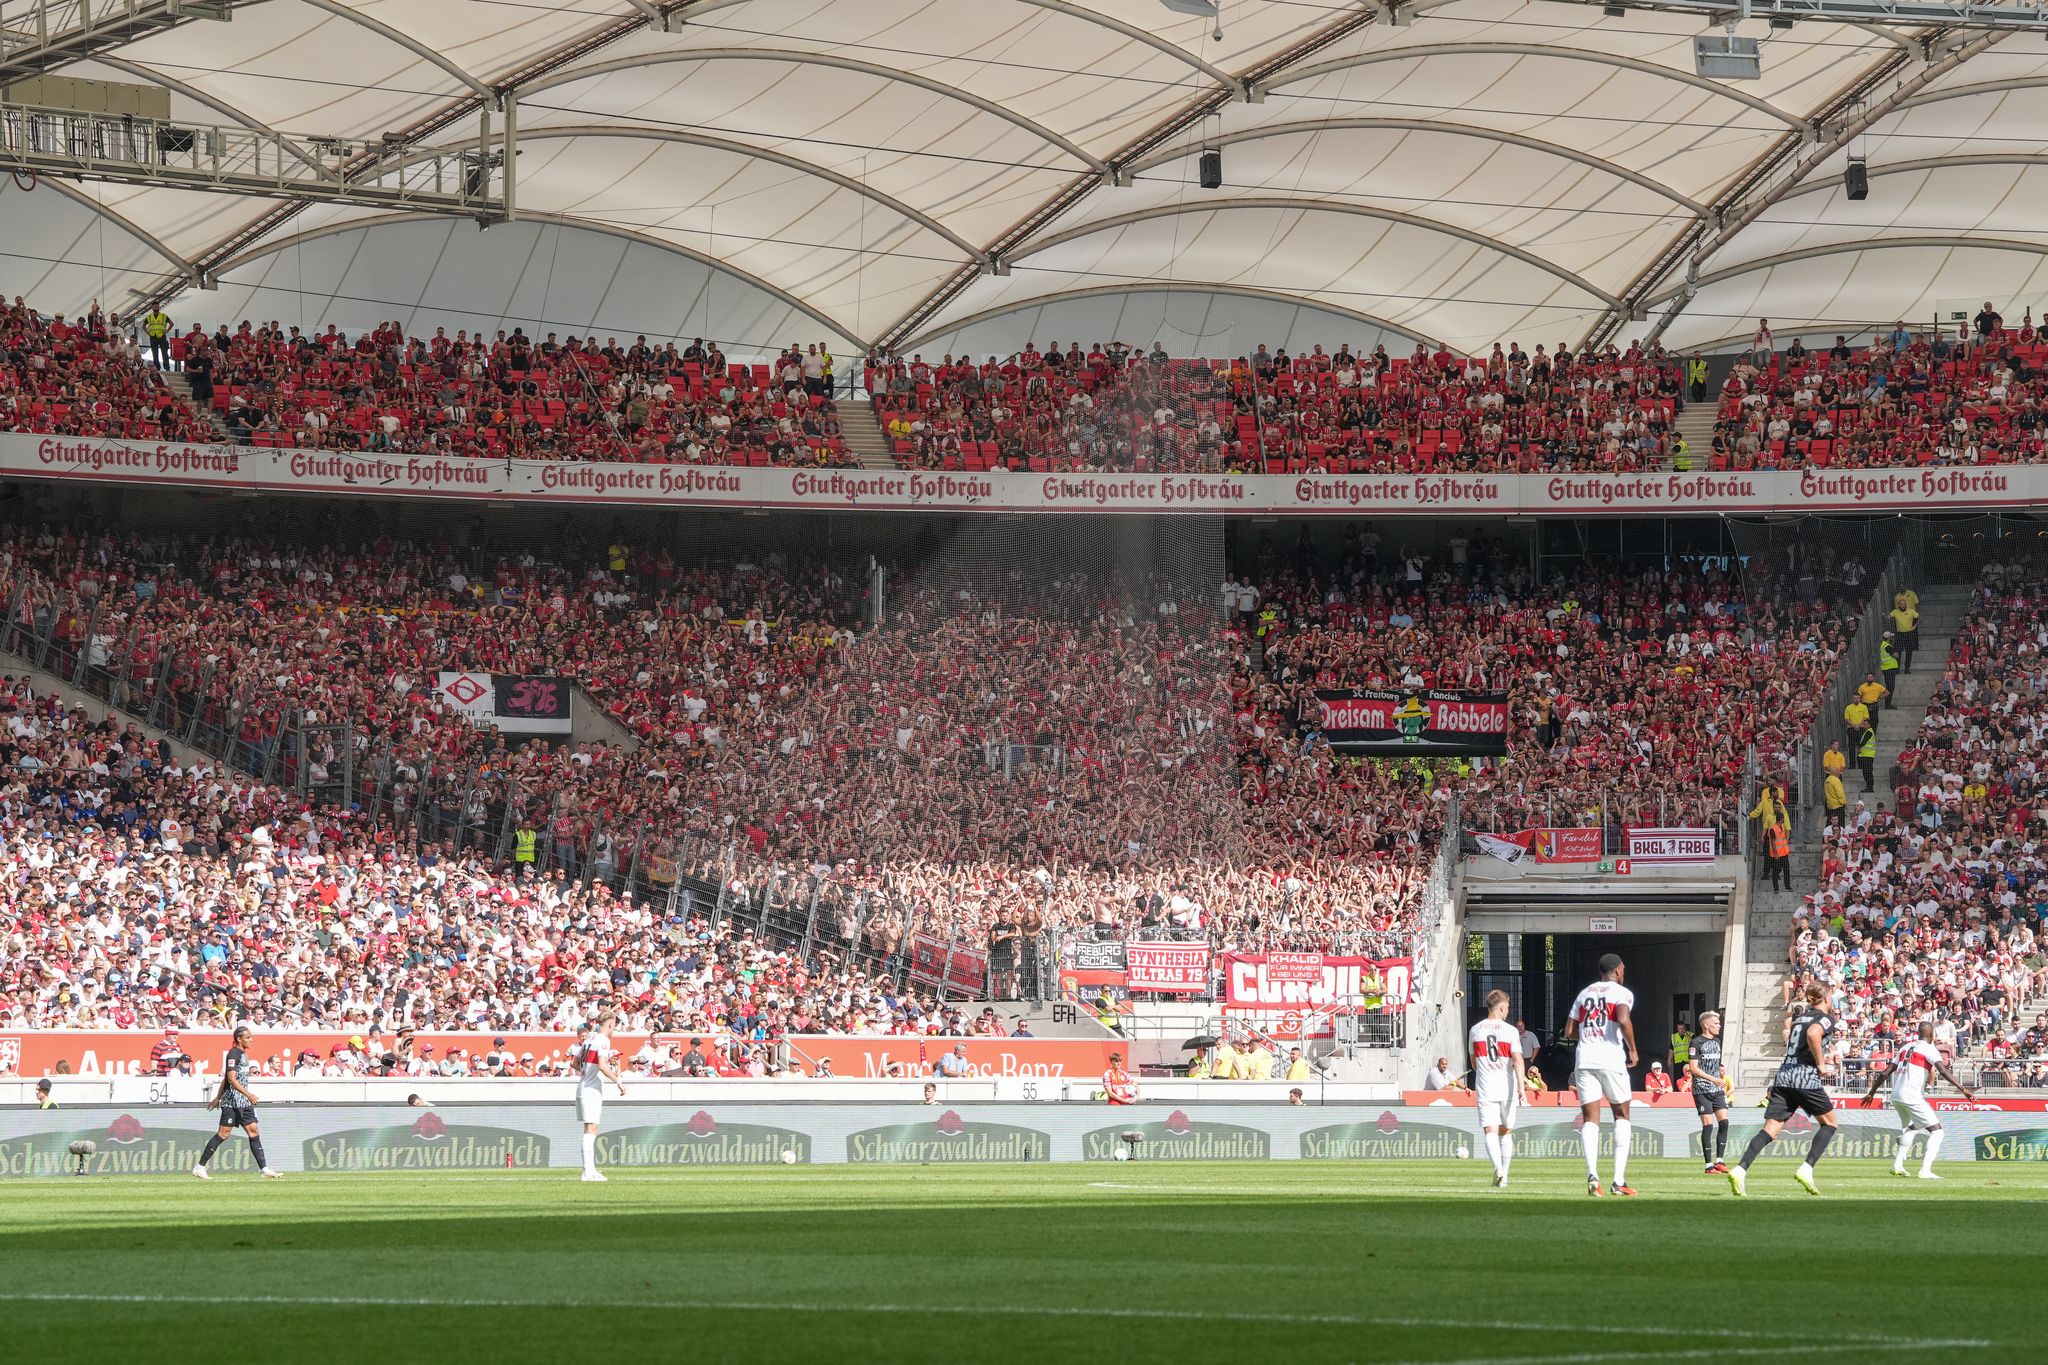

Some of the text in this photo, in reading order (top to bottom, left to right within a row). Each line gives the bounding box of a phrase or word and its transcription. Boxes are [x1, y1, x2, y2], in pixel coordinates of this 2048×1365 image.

[38, 438, 150, 470] Stuttgarter
[290, 453, 488, 485] Stuttgarter Hofbräu
[542, 465, 741, 494] Stuttgarter Hofbräu
[792, 472, 992, 500] Stuttgarter Hofbräu
[1043, 477, 1244, 504] Stuttgarter Hofbräu
[1295, 477, 1498, 505] Stuttgarter Hofbräu
[1548, 476, 1753, 504] Stuttgarter Hofbräu
[1800, 470, 2007, 500] Stuttgarter Hofbräu
[1353, 690, 1461, 702] SC Freiburg Fanclub
[1321, 701, 1504, 732] Dreisam Bobbele
[1678, 840, 1710, 854] FRBG
[1618, 861, 1627, 873] 4
[1129, 952, 1205, 966] SYNTHESIA
[1270, 955, 1319, 964] KHALID
[1290, 964, 1319, 972] IMMER
[1132, 968, 1183, 982] ULTRAS
[1053, 1005, 1076, 1024] EFH
[1487, 1034, 1499, 1062] 6
[1788, 1024, 1802, 1056] 9
[150, 1082, 168, 1102] 54
[1023, 1082, 1037, 1100] 55
[311, 1136, 542, 1169] Schwarzwaldmilch
